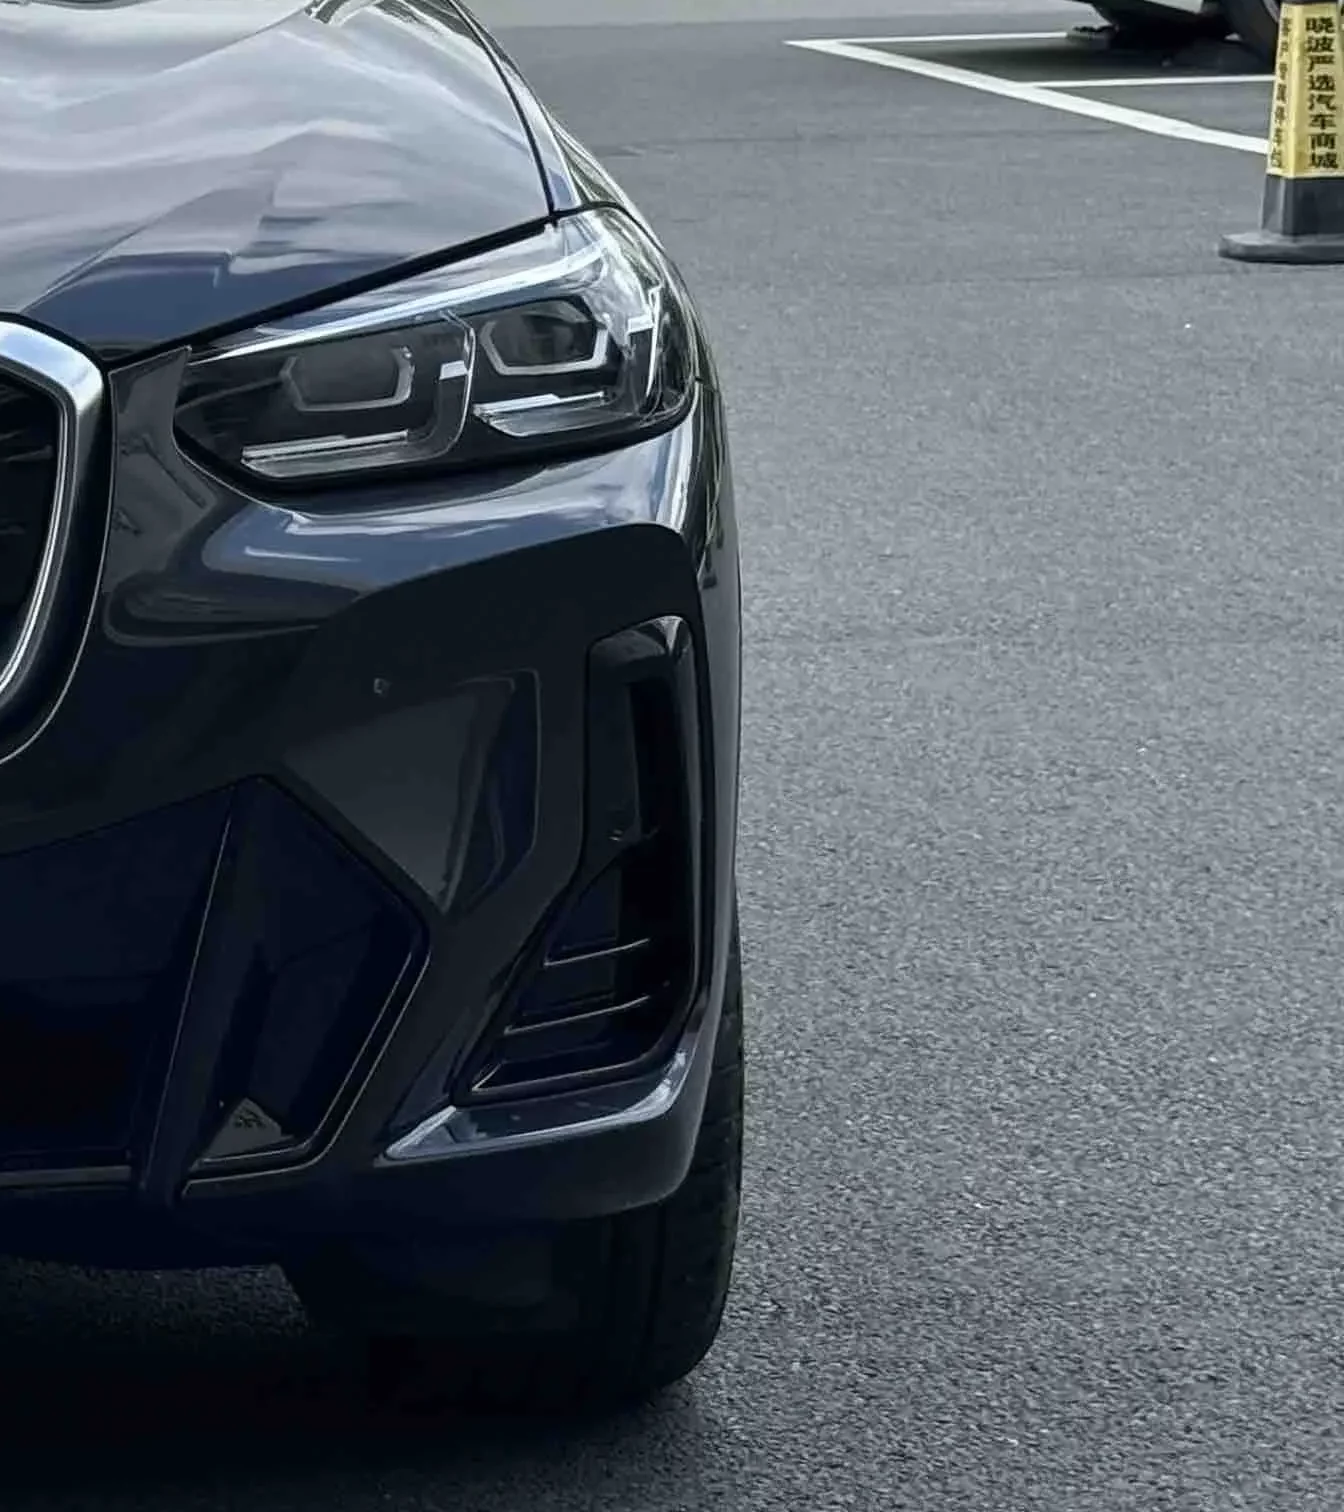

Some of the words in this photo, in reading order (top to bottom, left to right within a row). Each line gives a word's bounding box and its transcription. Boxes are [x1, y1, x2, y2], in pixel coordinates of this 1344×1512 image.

[1305, 16, 1337, 169] 晓波严选汽车商城
